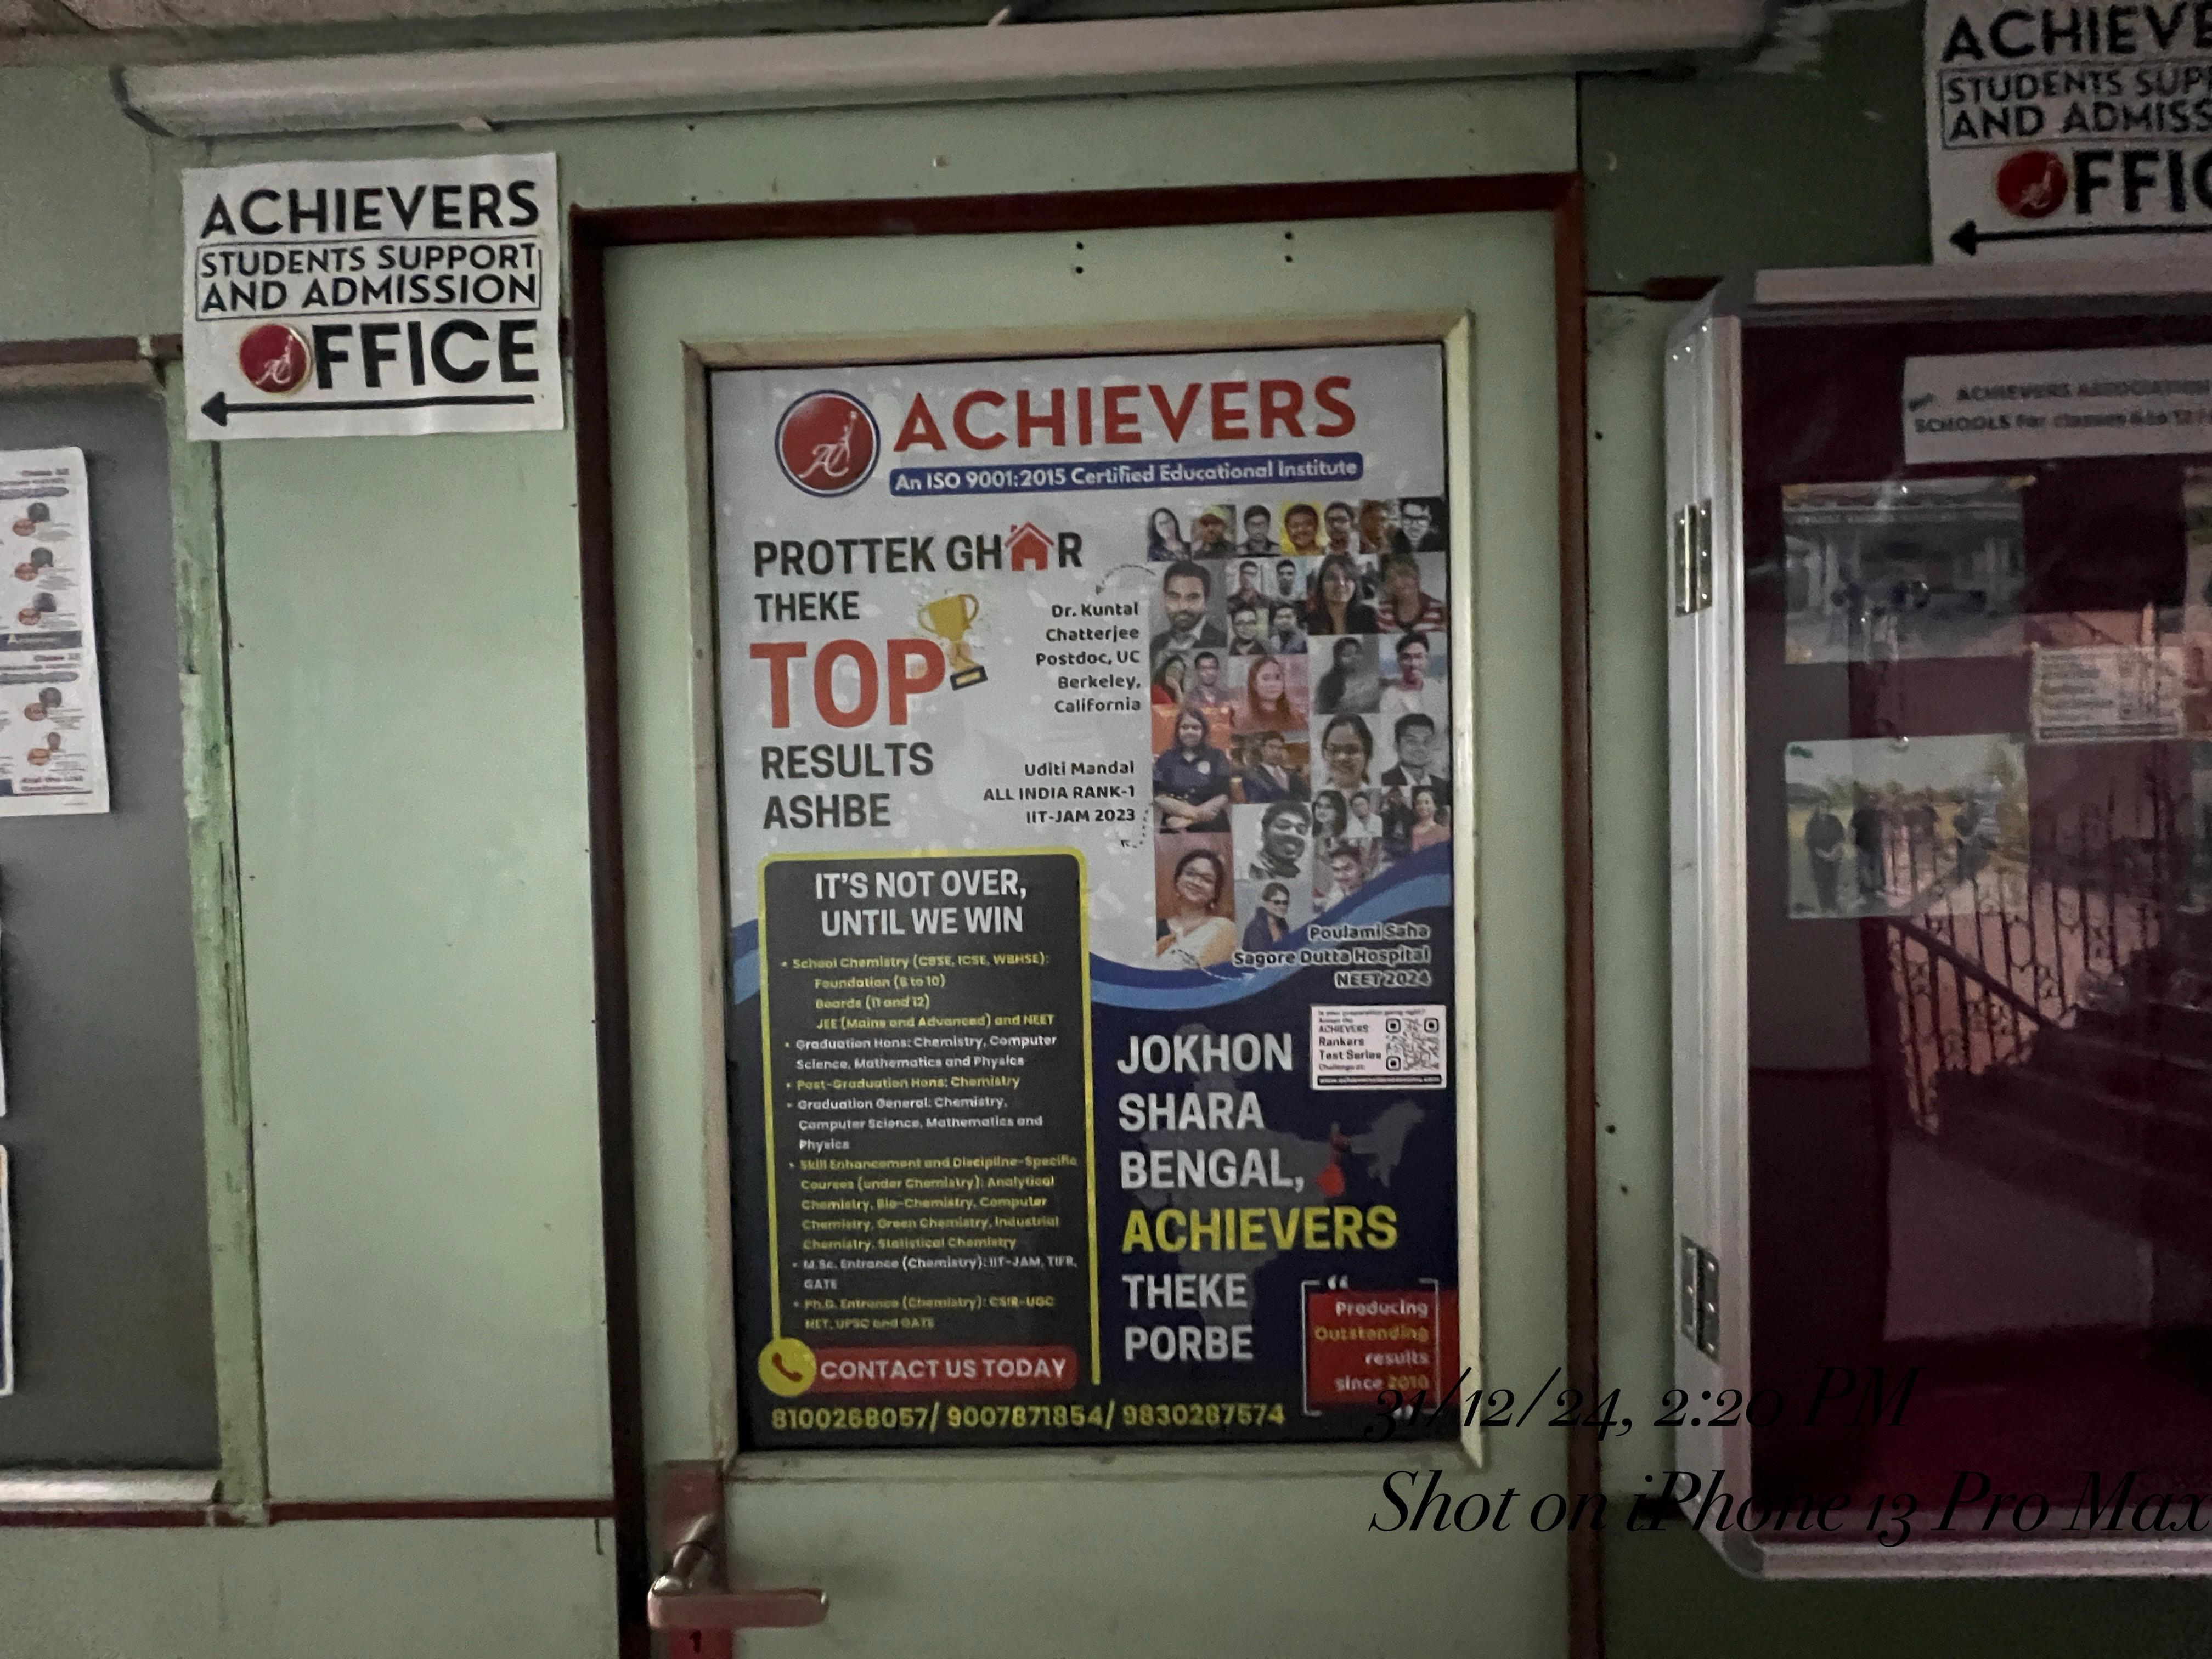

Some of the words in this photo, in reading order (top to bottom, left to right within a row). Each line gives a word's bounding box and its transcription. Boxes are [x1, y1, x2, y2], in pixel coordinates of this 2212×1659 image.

[1946, 69, 2122, 104] STUDENTS
[2136, 65, 2212, 97] SUP
[1950, 106, 2044, 142] AND
[201, 180, 539, 239] ACHIEVERS
[201, 246, 365, 278] STUDENTS
[378, 243, 535, 270] SUPPORT
[201, 280, 287, 313] AND
[302, 274, 535, 308] ADMISSION
[893, 377, 1357, 452] ACHIEVERS
[895, 475, 921, 490] An
[927, 472, 960, 489] ISO
[966, 468, 1065, 489] 9001:2015
[1071, 465, 1154, 484] Certified
[1160, 460, 1273, 481] Educational
[1278, 459, 1357, 477] Institute
[754, 537, 935, 577] PROTTEK
[754, 591, 860, 623] THEKE
[1052, 604, 1076, 618] Dr.
[1081, 602, 1138, 618] Kuntal
[1046, 625, 1139, 642] Chatterjee
[1036, 651, 1112, 666] Postdoc,
[1117, 650, 1140, 663] UC
[750, 639, 945, 729] TOP
[1054, 697, 1141, 713] California
[761, 742, 933, 780] RESULTS
[1025, 761, 1066, 776] Uditi
[1071, 760, 1134, 775] Mandal
[984, 788, 1015, 801] ALL
[1019, 787, 1068, 800] INDIA
[1074, 785, 1135, 799] RANK-1
[763, 793, 891, 830] ASHBE
[1027, 810, 1090, 823] IIT-JAM
[1095, 809, 1135, 822] 2023
[876, 870, 933, 898] NOT
[941, 868, 1027, 900] OVER,
[821, 908, 905, 936] UNTIL
[912, 907, 957, 934] WE
[964, 906, 1023, 933] WIN
[1308, 924, 1381, 941] Poulami
[1385, 921, 1430, 940] Saha
[793, 957, 837, 969] School
[840, 955, 909, 969] Chemistry
[1232, 951, 1296, 968] Sagore
[1300, 949, 1351, 965] Dutta
[1353, 945, 1431, 966] Hospital
[814, 977, 890, 989] Foundation
[911, 977, 923, 987] to
[926, 974, 945, 988] 10)
[1334, 972, 1381, 988] NEET
[1382, 970, 1432, 987] 2024
[816, 998, 862, 1009] Boards
[884, 996, 909, 1008] and
[913, 993, 930, 1010] 12)
[817, 1019, 837, 1029] JEE
[841, 1017, 886, 1030] (Mains
[889, 1018, 915, 1028] and
[918, 1013, 990, 1028] Advanced)
[995, 1015, 1020, 1026] and
[1024, 1014, 1054, 1026] NEET
[795, 1038, 871, 1050] Graduation
[914, 1035, 986, 1051] Chemistry,
[990, 1035, 1057, 1049] Computer
[1319, 1036, 1364, 1046] Rankers
[1117, 1032, 1293, 1074] JOKHON
[1319, 1049, 1344, 1060] Test
[1346, 1049, 1382, 1060] Series
[855, 1056, 942, 1069] Mathematics
[945, 1056, 970, 1067] and
[974, 1055, 1024, 1070] Physics
[797, 1077, 908, 1090] Post-Graduation
[951, 1076, 1019, 1090] Chemistry
[798, 1098, 873, 1110] Graduation
[935, 1096, 1007, 1109] Chemistry,
[1118, 1092, 1264, 1132] SHARA
[799, 1120, 865, 1132] Computer
[927, 1115, 1014, 1127] Mathematics
[1017, 1115, 1042, 1126] and
[799, 1138, 849, 1153] Physics
[800, 1159, 827, 1170] Skill
[830, 1158, 921, 1170] Enhancement
[924, 1157, 950, 1169] and
[953, 1154, 1077, 1170] Discipline-Specific
[1120, 1148, 1305, 1193] BENGAL,
[801, 1180, 854, 1191] Courses
[857, 1176, 902, 1193] (under
[988, 1176, 1054, 1190] Analytical
[980, 1197, 1047, 1210] Computer
[877, 1217, 916, 1229] Green
[996, 1216, 1059, 1228] Industrial
[1122, 1206, 1398, 1254] ACHIEVERS
[877, 1238, 945, 1250] Statistical
[948, 1236, 1016, 1250] Chemistry
[840, 1259, 899, 1270] Entrance
[804, 1279, 837, 1290] GATE
[1122, 1273, 1249, 1310] THEKE
[840, 1298, 899, 1310] Entrance
[1335, 1299, 1428, 1318] Producing
[873, 1318, 899, 1329] and
[1314, 1325, 1429, 1343] Outstanding
[1124, 1324, 1254, 1362] PORBE
[1365, 1349, 1429, 1366] results
[820, 1359, 938, 1380] CONTACT
[946, 1359, 977, 1379] US
[981, 1357, 1066, 1379] TODAY
[1335, 1375, 1384, 1392] since
